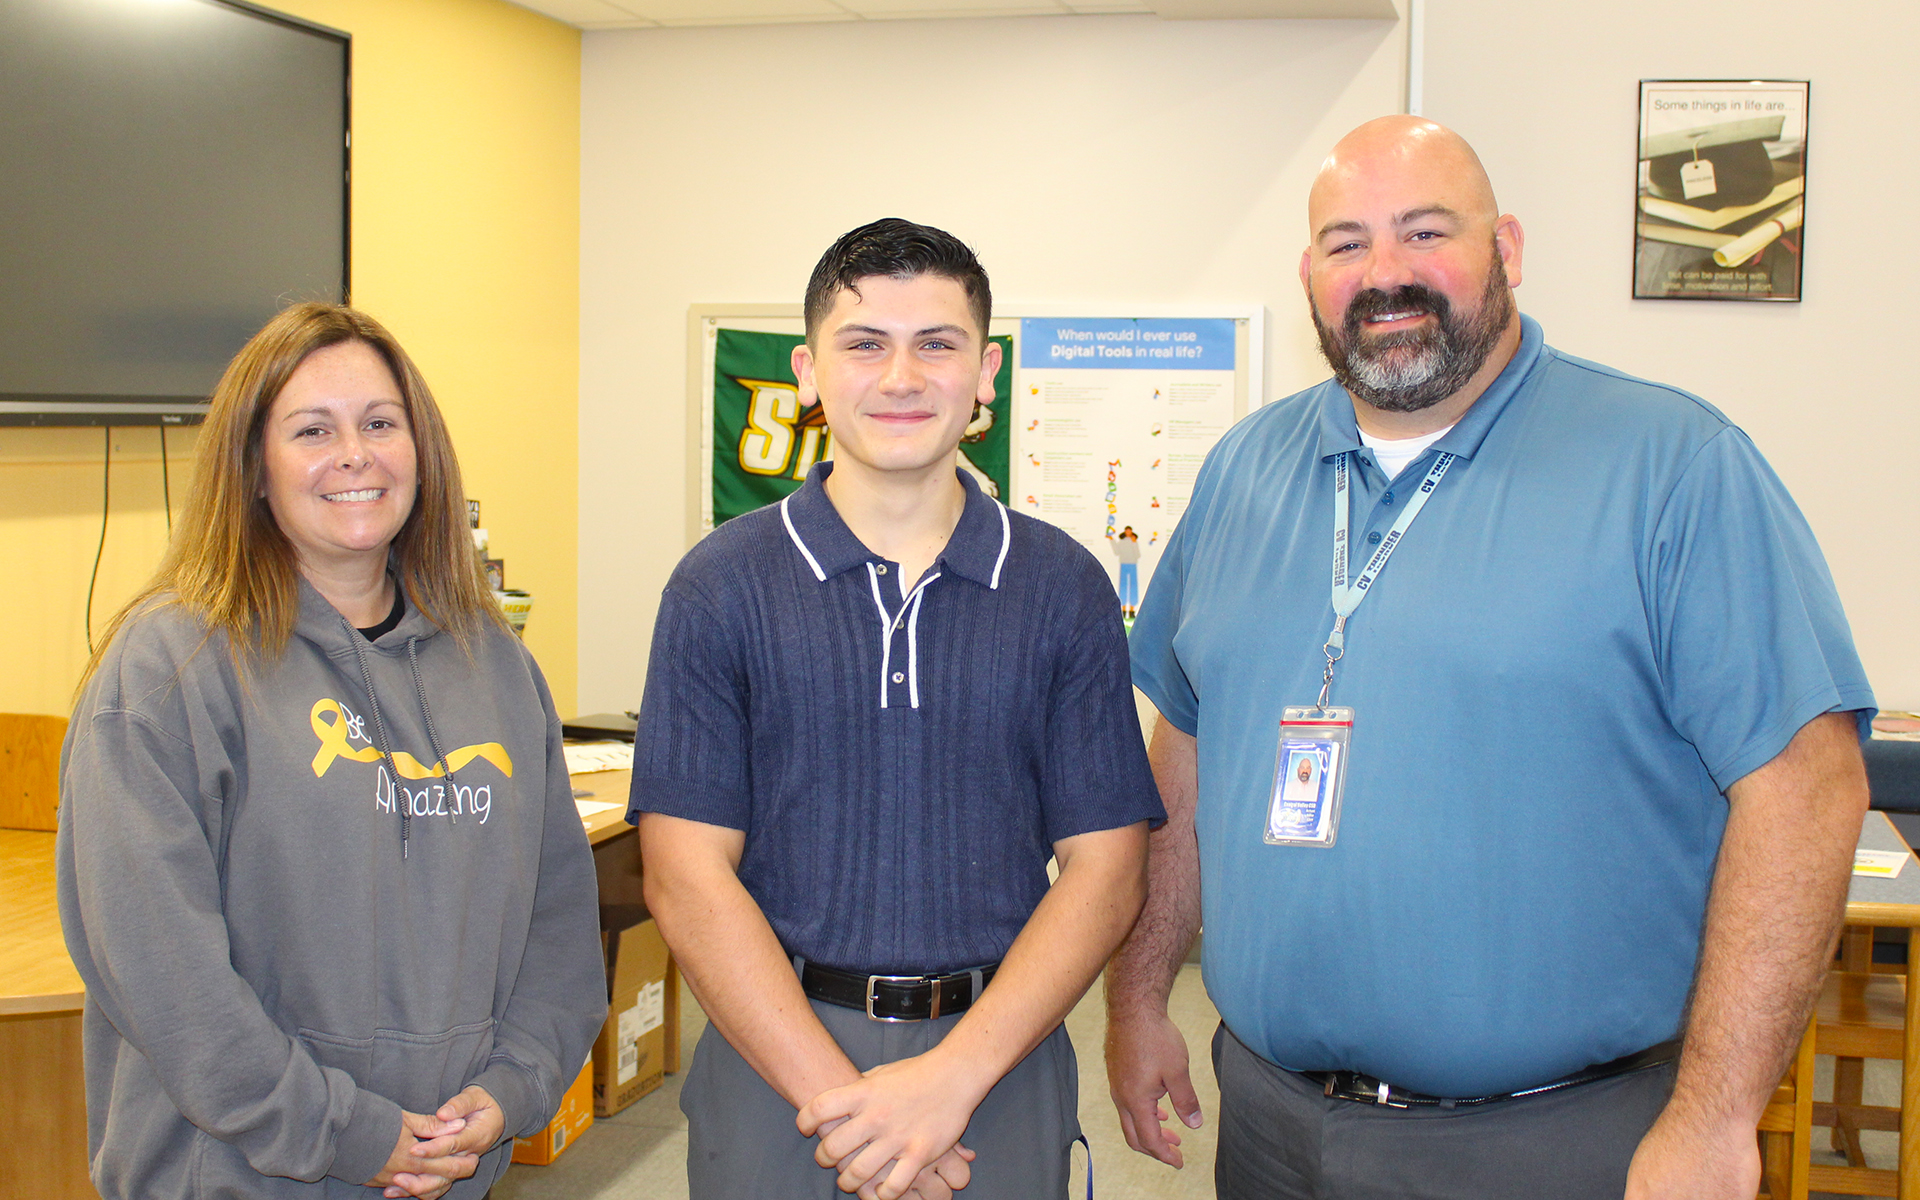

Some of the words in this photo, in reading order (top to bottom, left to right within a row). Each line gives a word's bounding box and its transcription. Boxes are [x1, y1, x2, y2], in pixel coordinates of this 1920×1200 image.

[1654, 99, 1688, 111] Some
[1692, 99, 1727, 113] things
[1731, 100, 1741, 110] in
[1744, 99, 1762, 110] life
[1683, 271, 1700, 279] can
[1701, 271, 1713, 279] be
[1714, 271, 1734, 281] paid
[1735, 271, 1747, 280] for
[1748, 272, 1767, 280] with
[1685, 282, 1730, 290] motivation
[1730, 282, 1748, 290] and
[1057, 329, 1093, 341] When
[1096, 330, 1134, 341] would
[1136, 330, 1141, 341] I
[1143, 331, 1172, 341] ever
[1174, 332, 1197, 342] use
[1051, 345, 1095, 360] Digital
[1097, 345, 1133, 357] Tools
[1136, 346, 1146, 357] in
[1149, 346, 1174, 358] real
[1175, 346, 1203, 358] life?
[1421, 479, 1436, 493] CV
[1336, 529, 1346, 543] CV
[1334, 544, 1346, 587] THUNDER
[1356, 575, 1372, 590] CV
[1366, 530, 1402, 573] THUNDER
[338, 701, 373, 744] Be
[375, 764, 492, 825] Amazng
